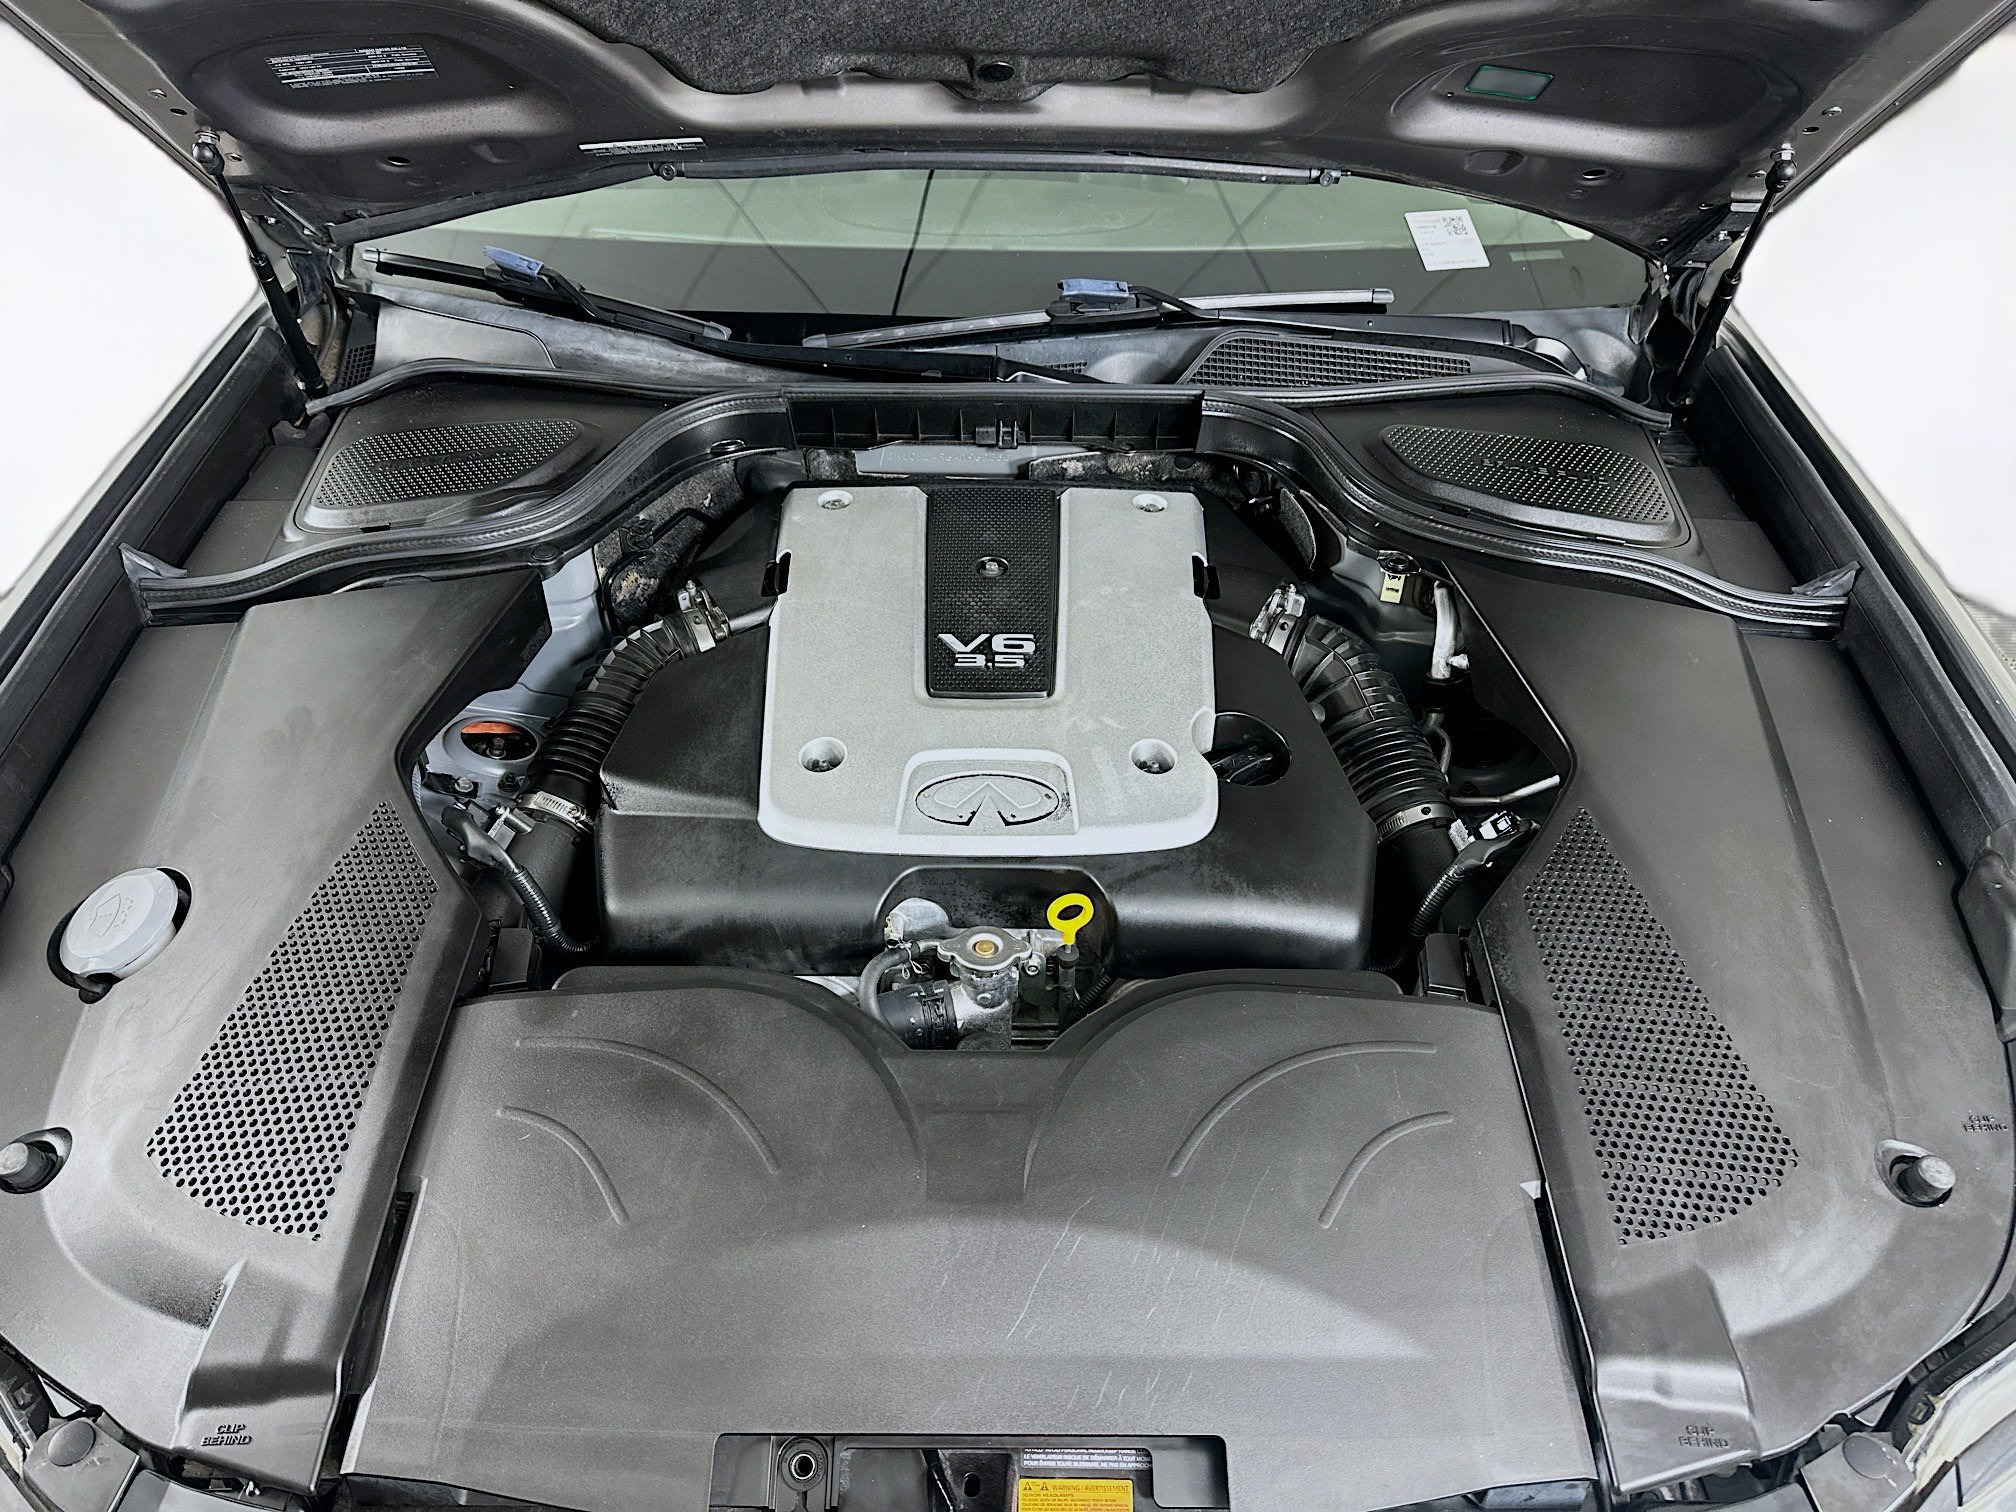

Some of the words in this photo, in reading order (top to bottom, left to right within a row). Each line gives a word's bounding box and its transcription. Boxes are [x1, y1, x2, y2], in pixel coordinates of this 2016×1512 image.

[937, 633, 1036, 654] V6
[954, 653, 1026, 669] 3.5
[1968, 1114, 1995, 1124] CLIP
[1962, 1123, 2008, 1132] BEHIND
[216, 1423, 247, 1435] CLIP
[1685, 1424, 1714, 1436] CLIP
[200, 1434, 253, 1447] BEHIND
[1678, 1436, 1730, 1449] BEHIND
[1084, 1484, 1129, 1492] AVERTISSEMENT
